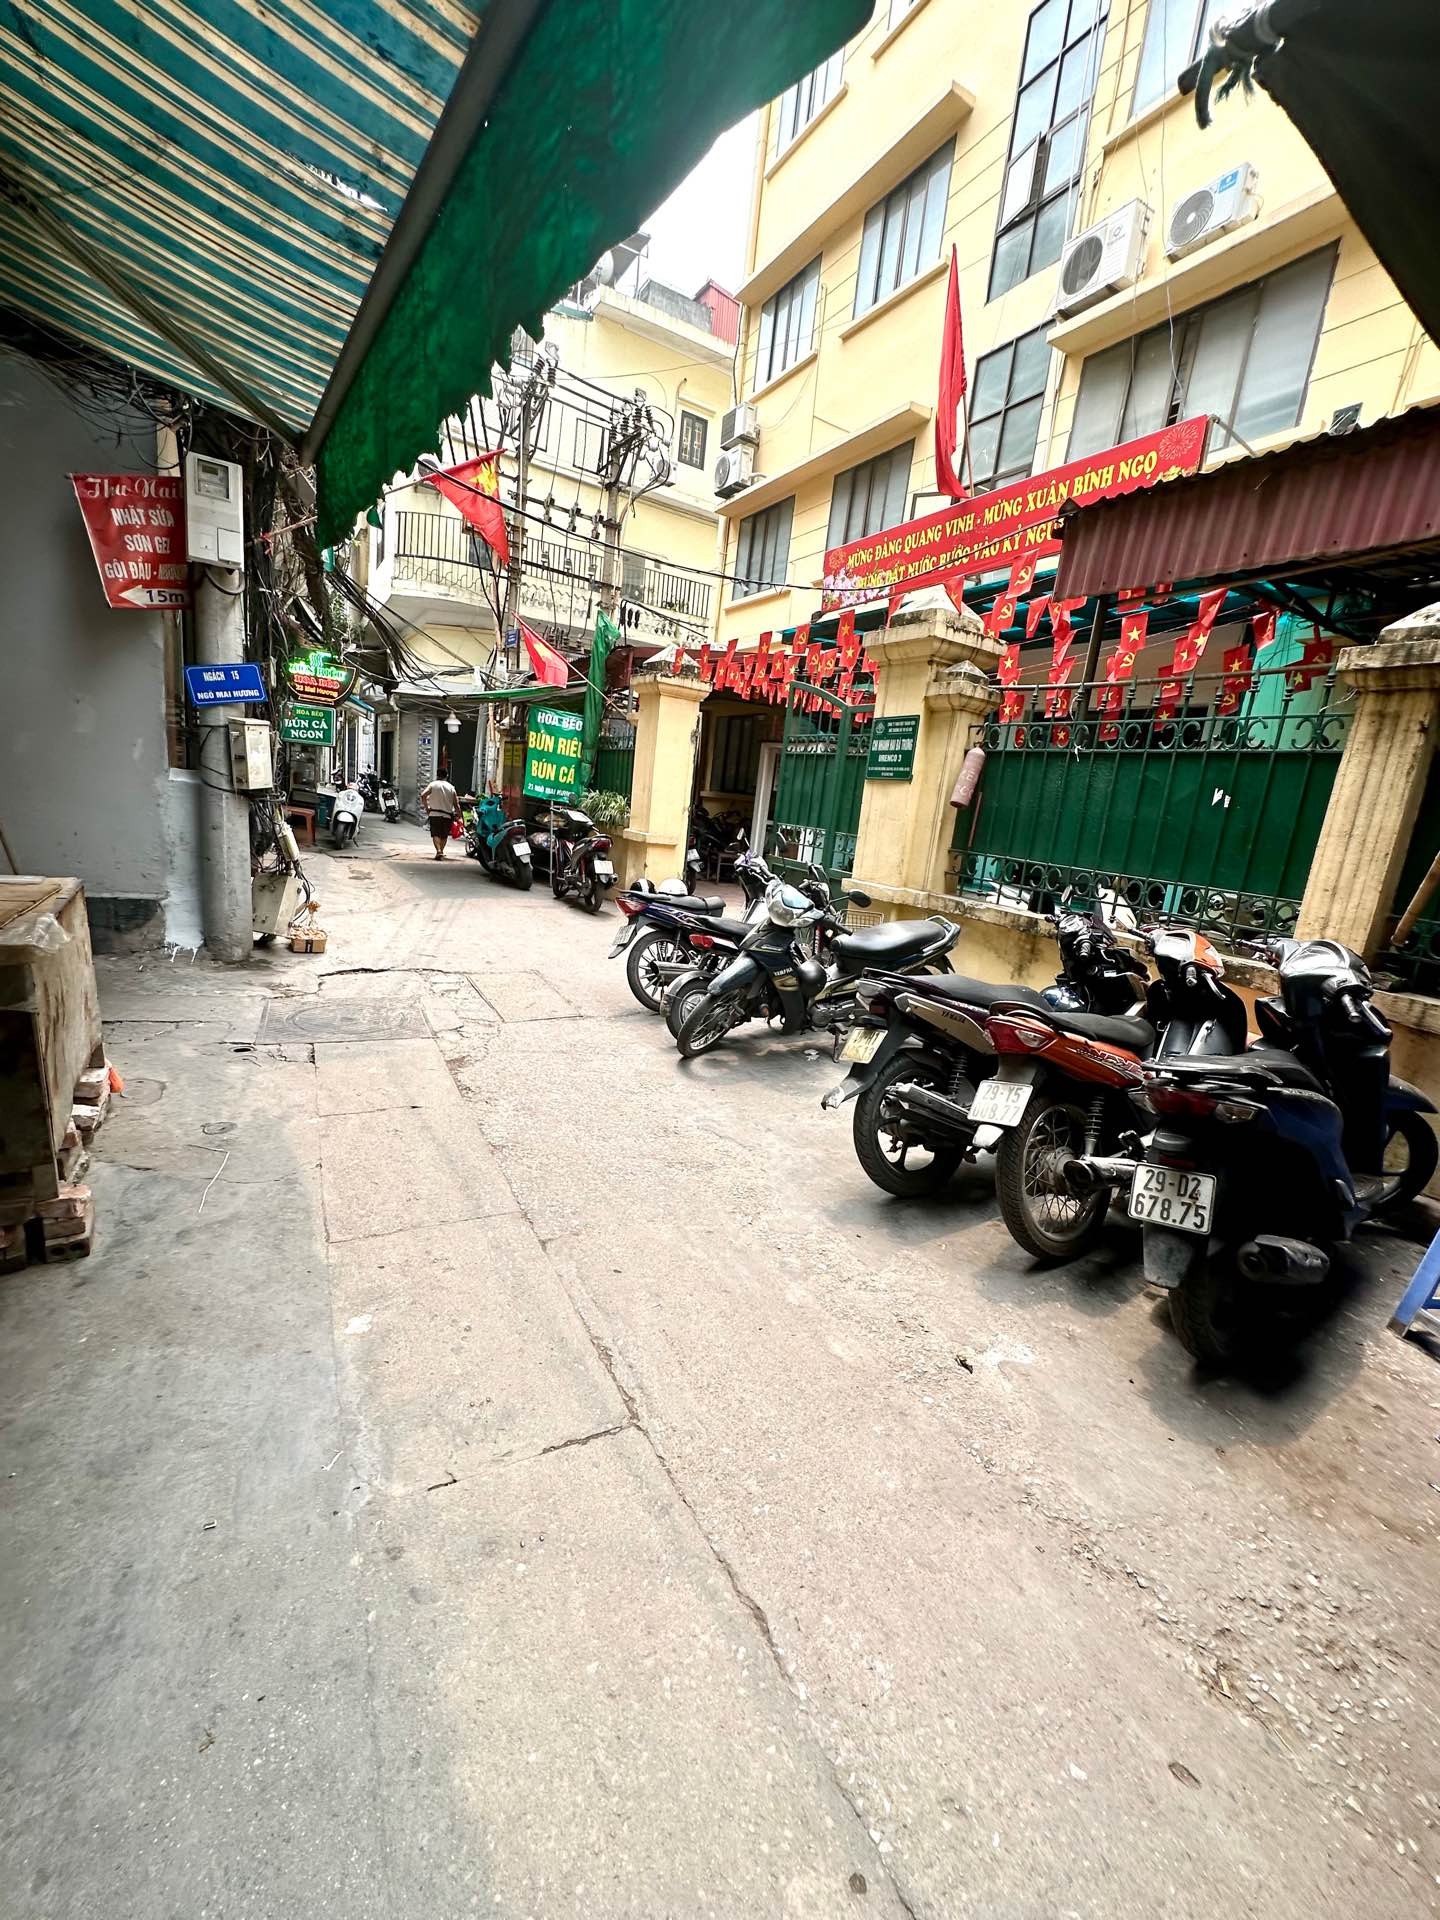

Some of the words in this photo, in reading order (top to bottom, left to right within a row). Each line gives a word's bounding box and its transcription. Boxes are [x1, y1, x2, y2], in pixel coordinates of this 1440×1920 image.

[848, 550, 873, 570] MỪNG
[875, 536, 903, 561] ĐẢNG
[904, 529, 942, 553] QUANG
[945, 517, 973, 538] VINH
[983, 499, 1023, 527] MỪNG
[1025, 480, 1070, 513] XUÂN
[1072, 467, 1115, 498] BÍNH
[1117, 450, 1158, 483] NGỌ
[155, 535, 171, 554] GEL
[971, 536, 1001, 561] VÀO
[146, 589, 185, 603] 15m
[203, 669, 225, 681] NGÁCH
[231, 670, 240, 680] 15
[216, 690, 232, 698] MAI
[312, 718, 328, 729] CÁ
[537, 711, 560, 726] HOA
[562, 715, 583, 731] BÉO
[289, 729, 324, 739] NGON
[528, 729, 555, 752] BÚN
[531, 758, 556, 781] BÚN
[559, 764, 575, 784] CÁ
[982, 1084, 1024, 1103] 29-Y5
[1143, 1168, 1201, 1200] 29-D2
[1134, 1193, 1207, 1229] 678.75
